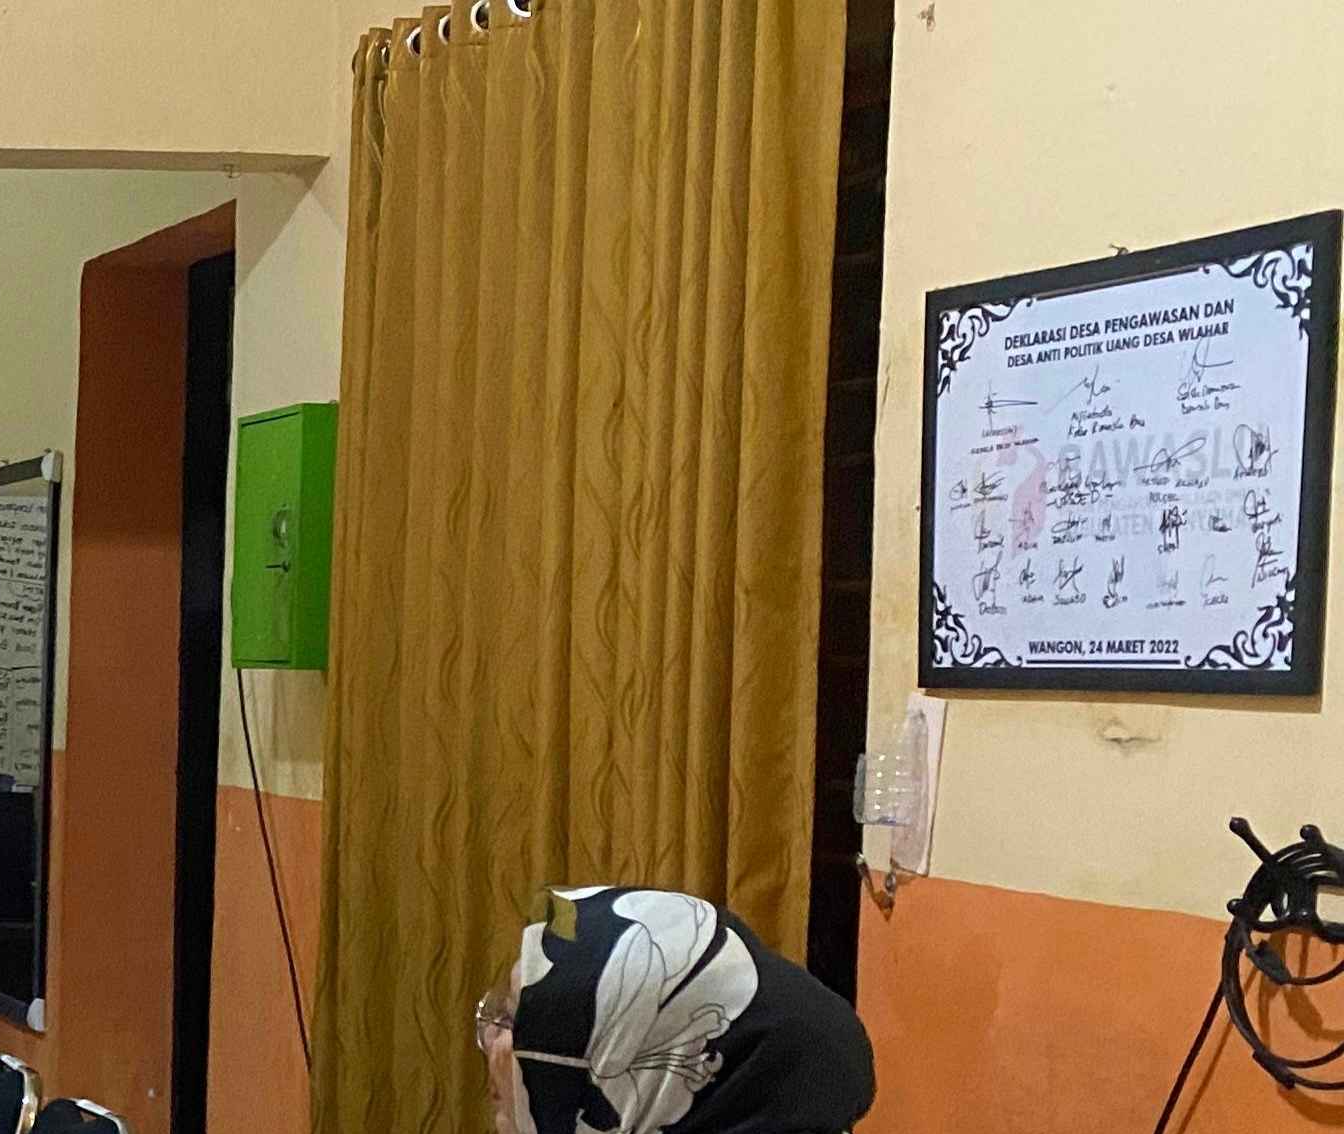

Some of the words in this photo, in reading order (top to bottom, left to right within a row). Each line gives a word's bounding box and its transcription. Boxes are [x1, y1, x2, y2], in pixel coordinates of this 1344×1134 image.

[1005, 327, 1066, 351] DEKLARASI
[1070, 321, 1100, 339] DESA
[1105, 304, 1200, 333] PENGAWASAN
[1204, 298, 1235, 319] DAN
[1008, 351, 1034, 368] DESA
[1036, 347, 1061, 364] ANTI
[1064, 341, 1103, 360] POLITIK
[1106, 336, 1140, 353] UANG
[1144, 330, 1174, 348] DESA
[1178, 321, 1229, 342] WLAHAR
[1029, 641, 1086, 655] WANGON,
[1089, 641, 1103, 654] 24
[1105, 640, 1145, 655] MARET
[1150, 640, 1180, 654] 2022
